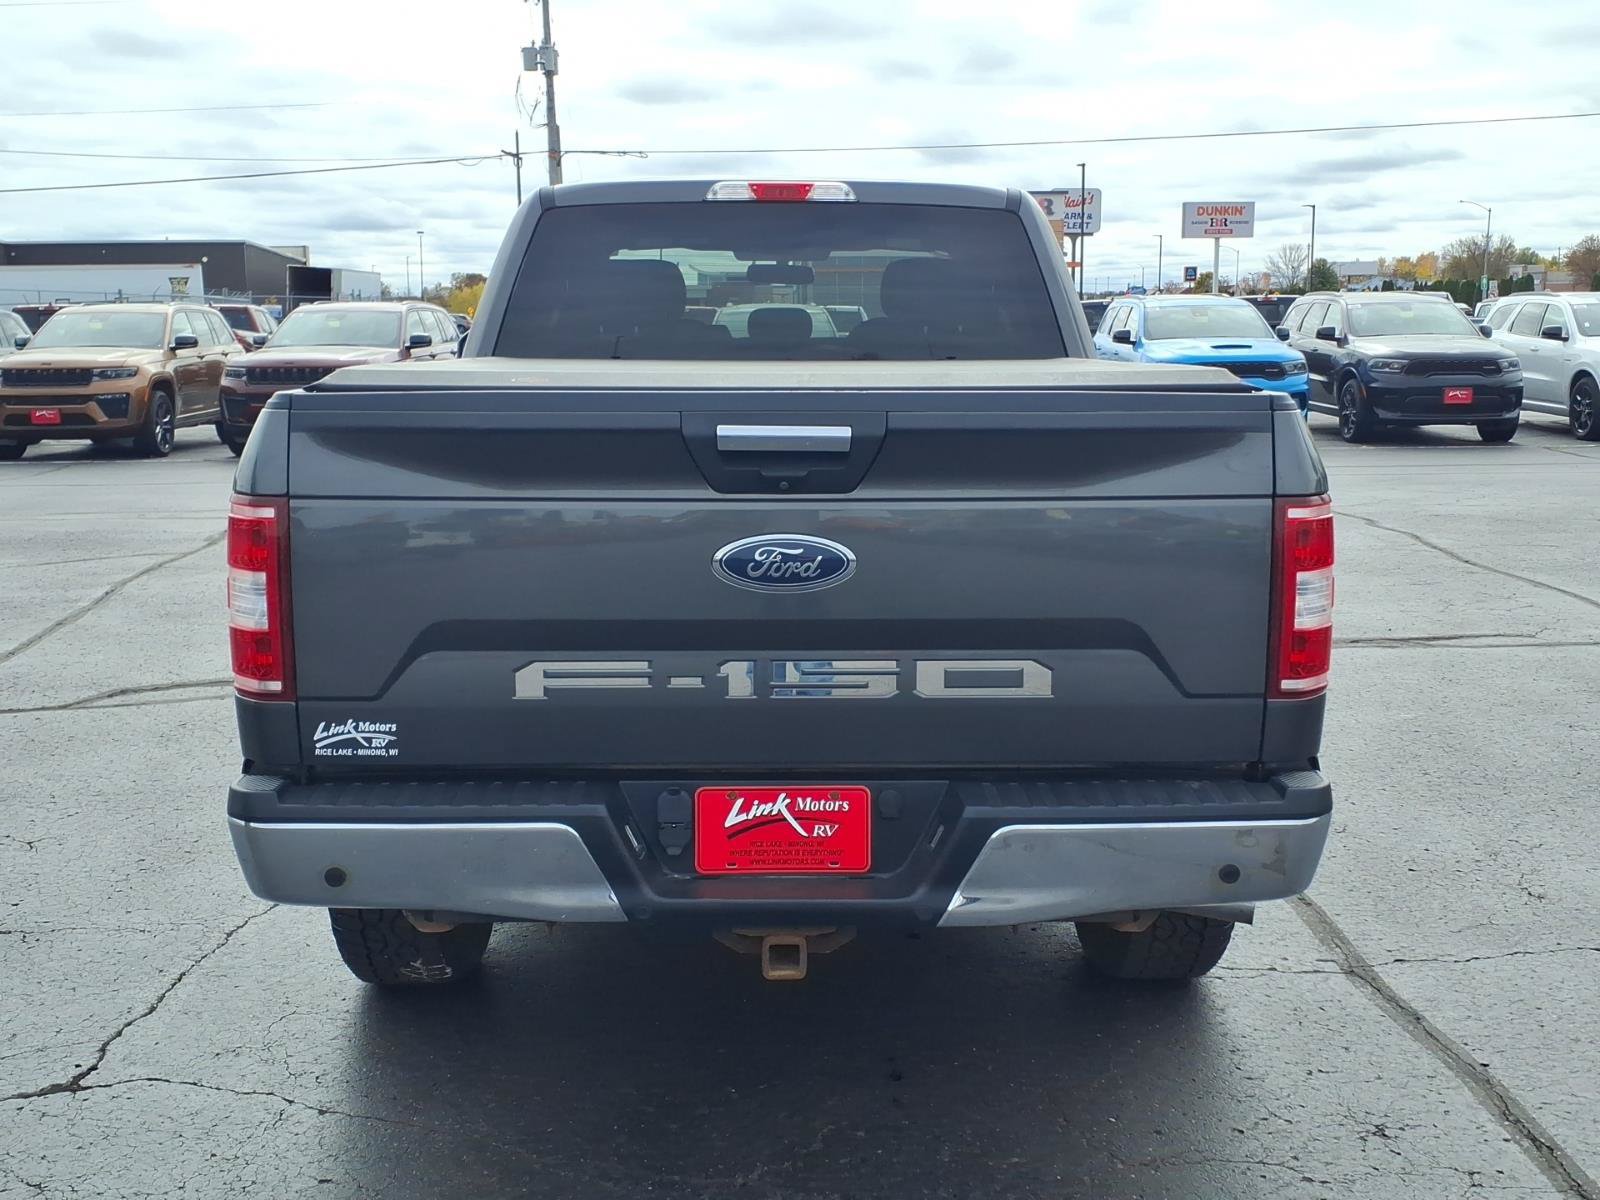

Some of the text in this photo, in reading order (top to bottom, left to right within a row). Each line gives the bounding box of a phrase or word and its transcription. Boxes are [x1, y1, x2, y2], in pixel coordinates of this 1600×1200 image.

[1196, 205, 1246, 216] DUNKIN'
[746, 546, 823, 578] Ford
[512, 659, 1055, 700] F-150
[313, 719, 397, 748] Link Motors
[371, 738, 389, 747] RV
[315, 748, 399, 757] RICE LAKE MINONG, WI
[724, 793, 850, 838] Link Motors
[812, 824, 839, 837] RV
